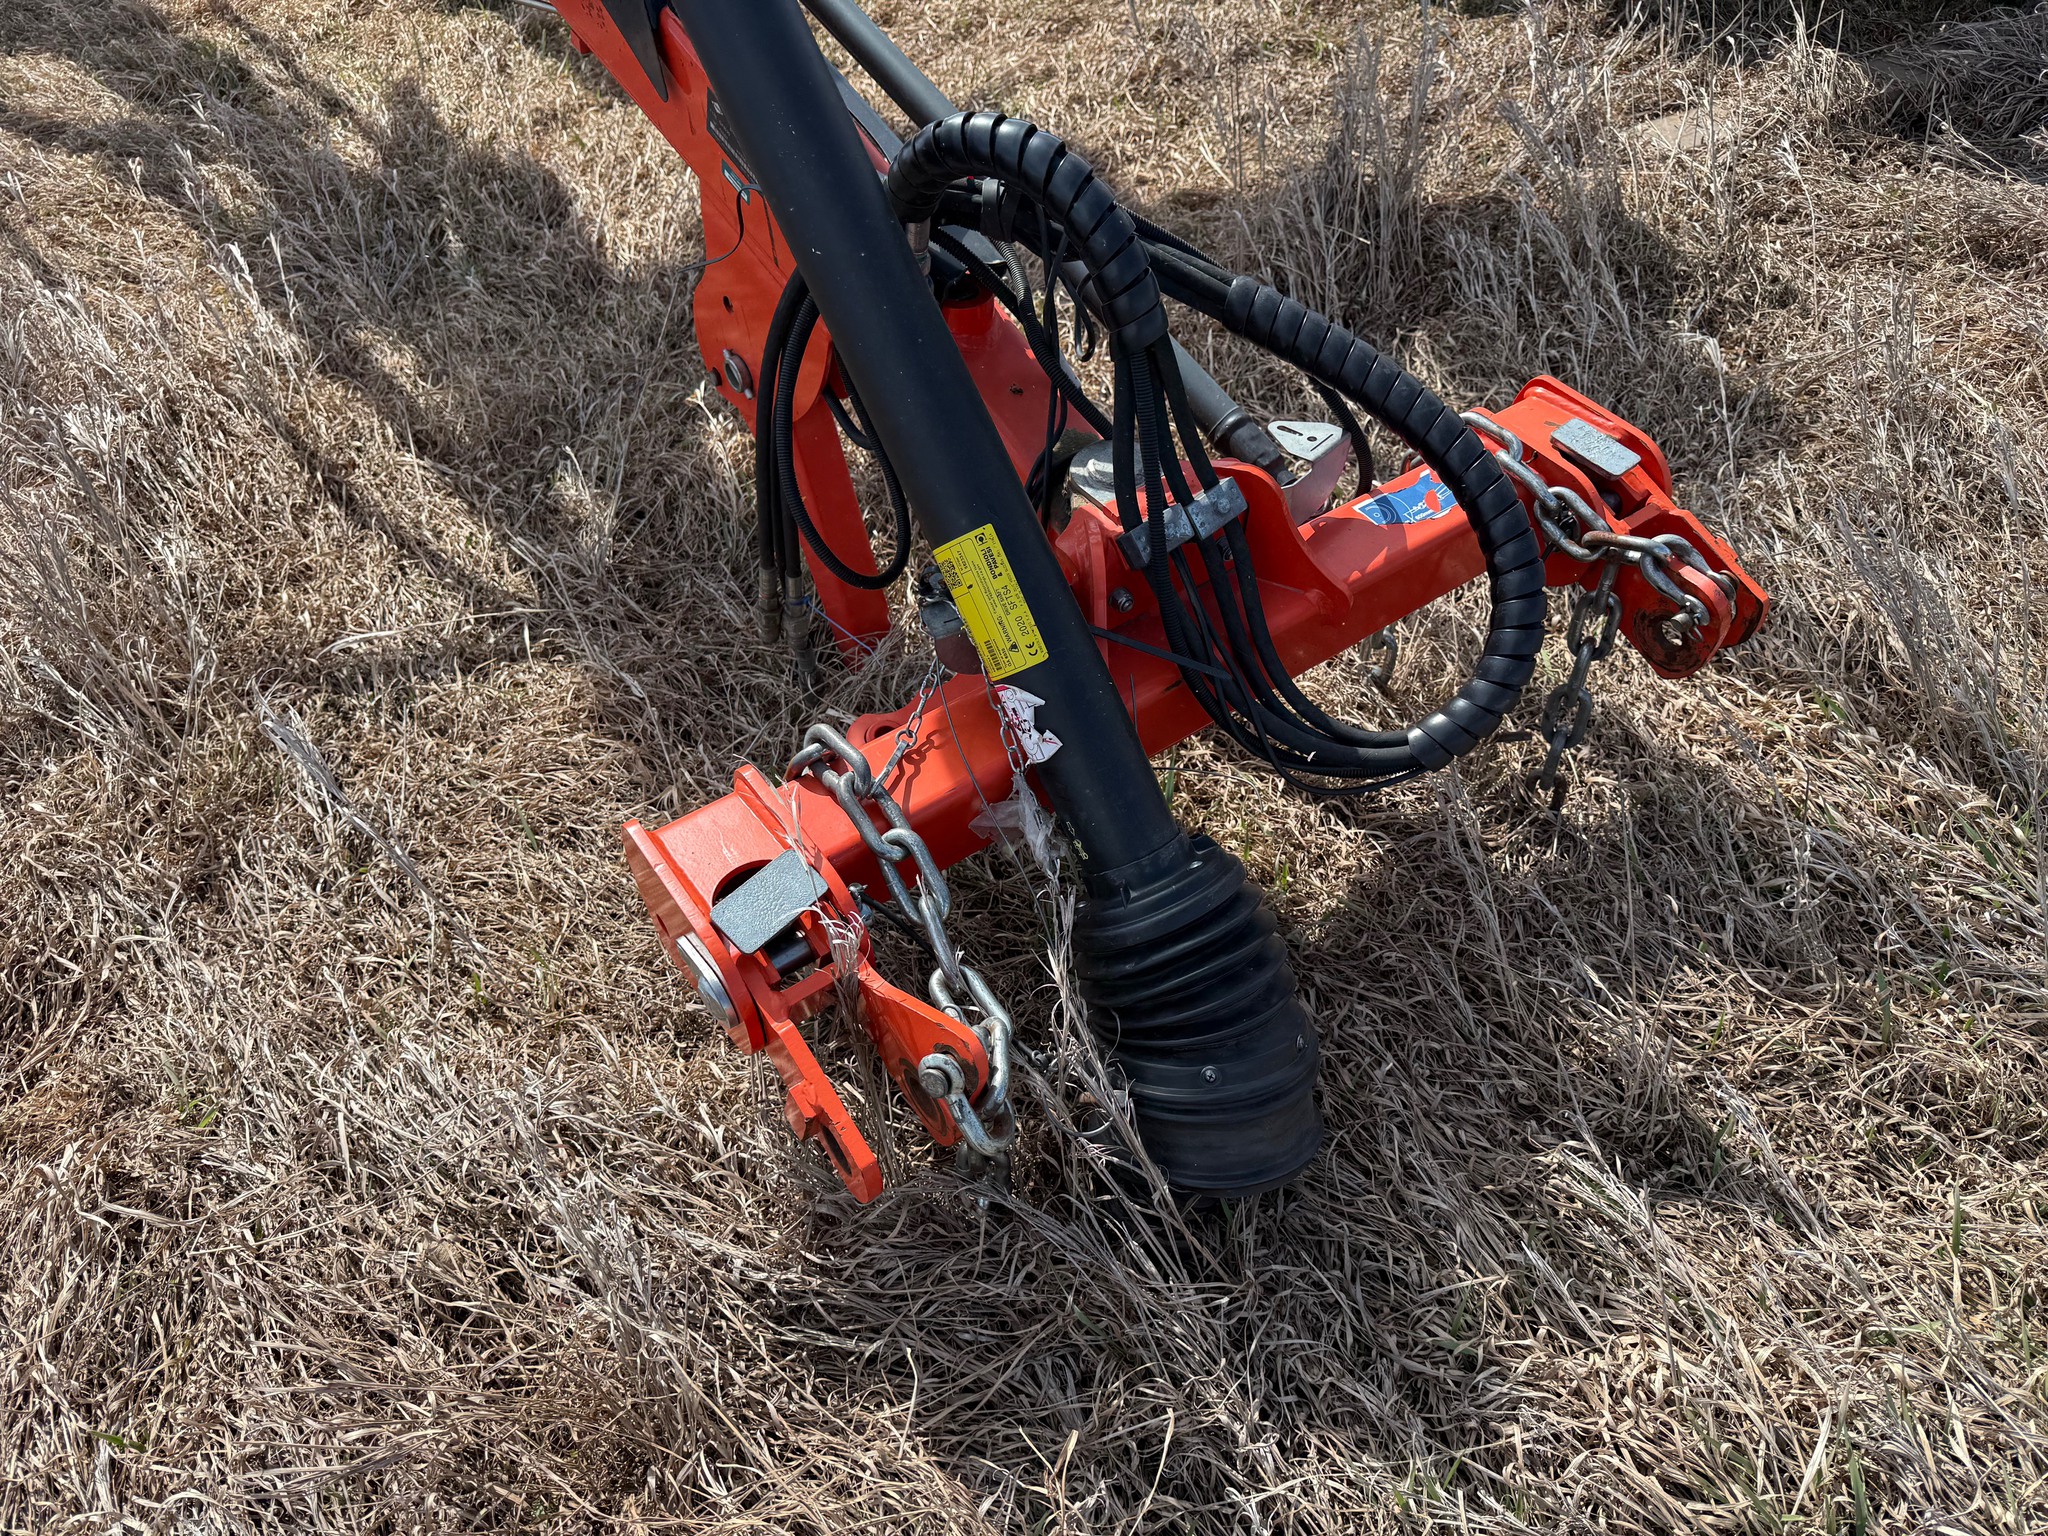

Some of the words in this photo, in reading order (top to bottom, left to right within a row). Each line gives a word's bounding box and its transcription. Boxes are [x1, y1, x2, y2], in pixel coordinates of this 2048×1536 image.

[980, 548, 998, 579] BONDIOLI
[985, 545, 999, 568] PAVESI
[1013, 614, 1029, 637] 2020
